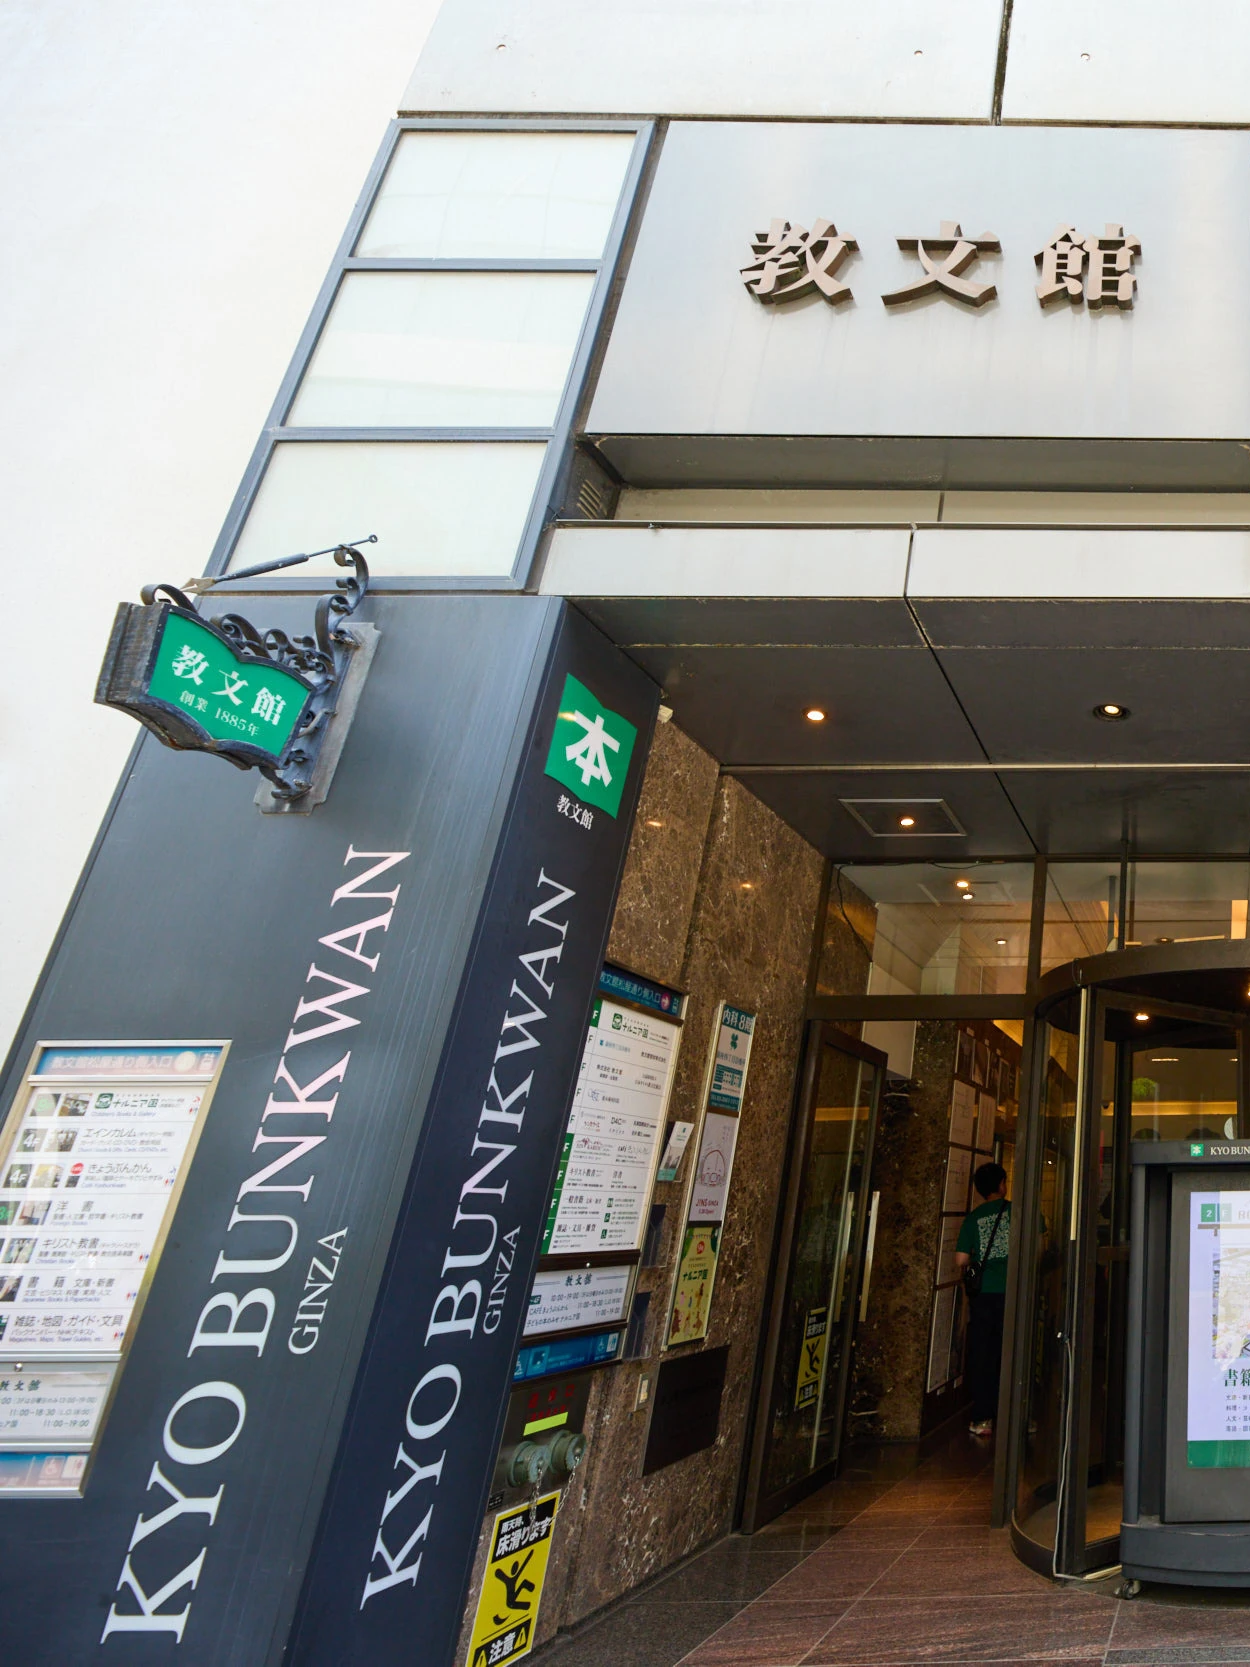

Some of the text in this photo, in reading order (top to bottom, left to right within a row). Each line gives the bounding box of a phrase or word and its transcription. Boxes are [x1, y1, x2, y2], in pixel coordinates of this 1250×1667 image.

[740, 218, 1142, 311] 教文館
[172, 644, 287, 726] 教文館
[179, 690, 260, 737] 創業 1885年
[556, 794, 594, 830] 教文館
[723, 1008, 739, 1027] 内科
[622, 1023, 648, 1039] ナルニア国
[113, 1099, 158, 1108] ナルニア国
[83, 1128, 136, 1138] エインカレム
[10, 1169, 28, 1184] 4F
[88, 1162, 152, 1174] きょうぶんかん
[43, 1238, 100, 1249] キリスト教書
[74, 1278, 115, 1288] 文庫・新書
[483, 1224, 522, 1336] GINZA
[565, 1273, 593, 1287] 教文館
[288, 1226, 349, 1356] GINZA
[496, 1517, 552, 1557] 床滑ります
[488, 1632, 516, 1664] 注意
